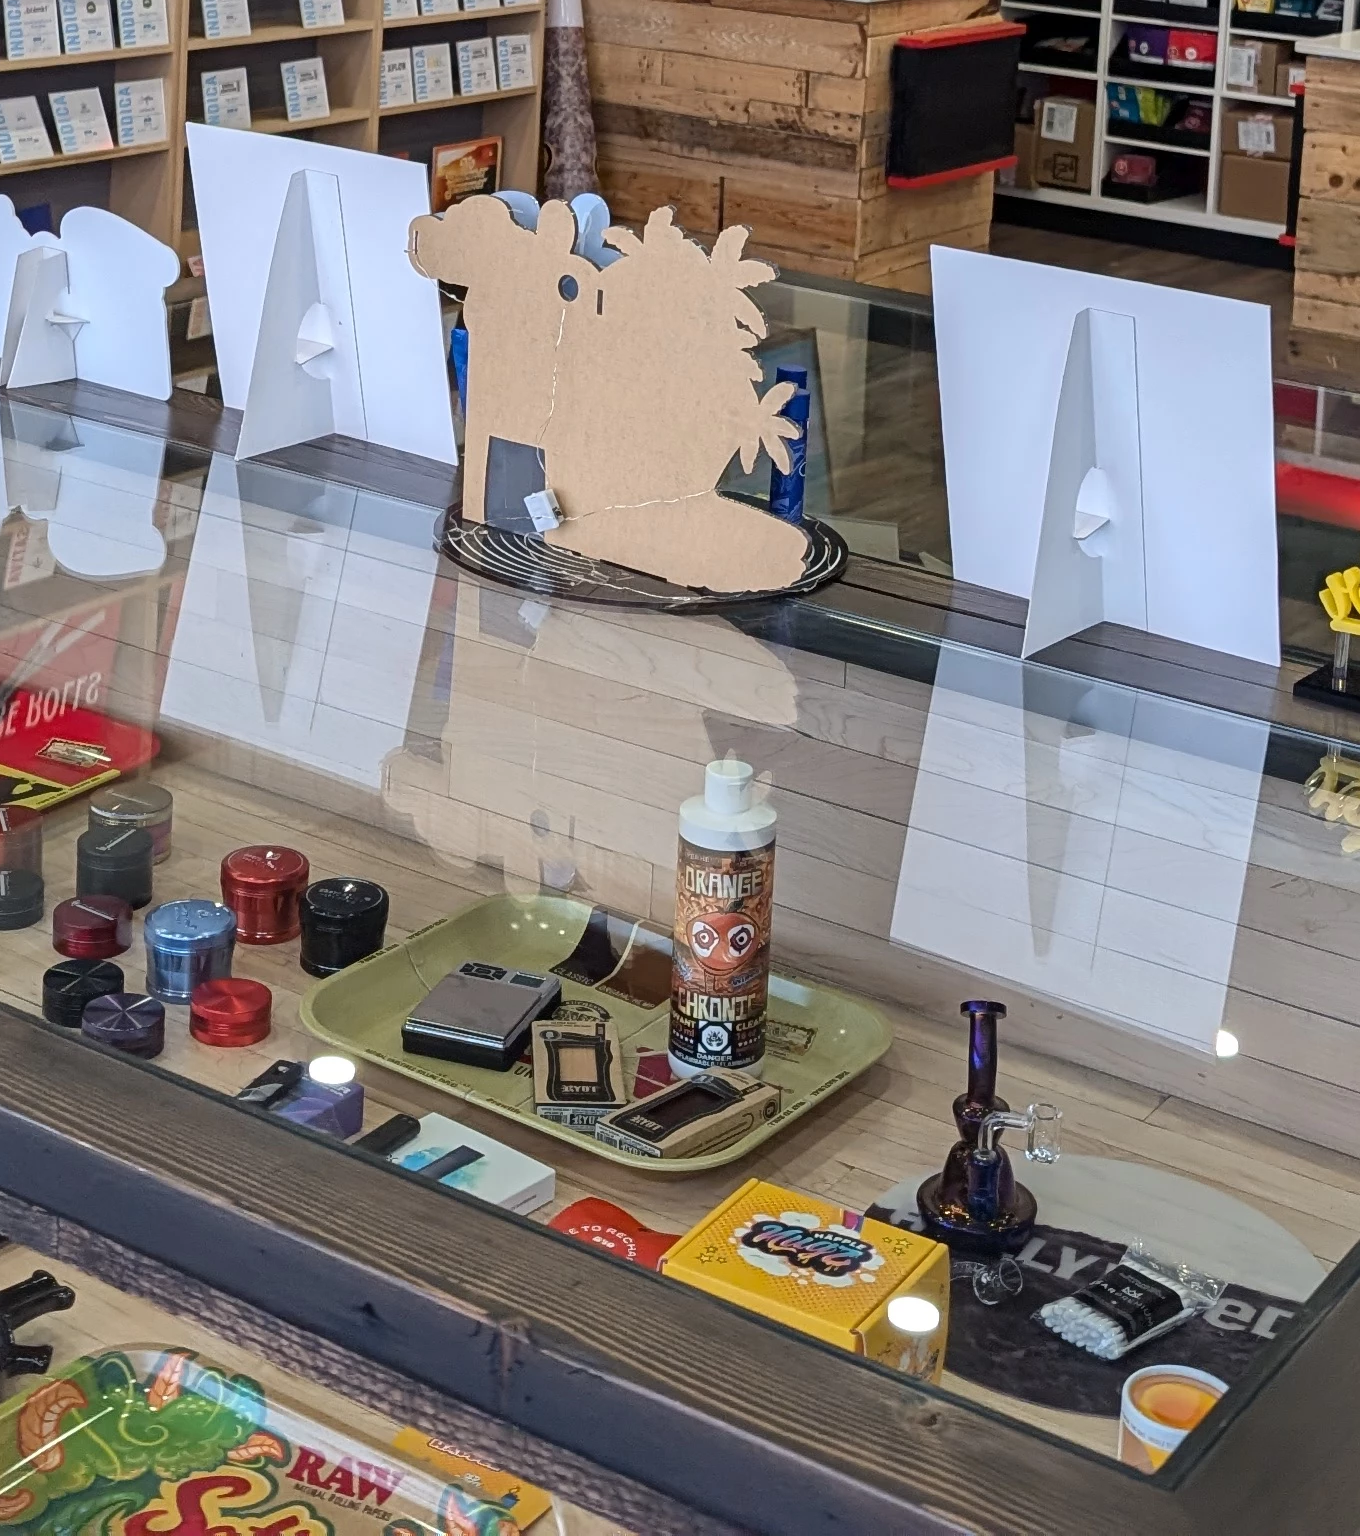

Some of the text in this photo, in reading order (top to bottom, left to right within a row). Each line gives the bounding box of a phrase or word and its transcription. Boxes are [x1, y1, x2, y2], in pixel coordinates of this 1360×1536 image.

[684, 867, 764, 898] ORANGE
[552, 966, 595, 986] CLASSIC
[581, 1224, 602, 1233] TO
[286, 1445, 408, 1507] RAW
[293, 1482, 394, 1522] NATURAL ROLLING PAPERS
